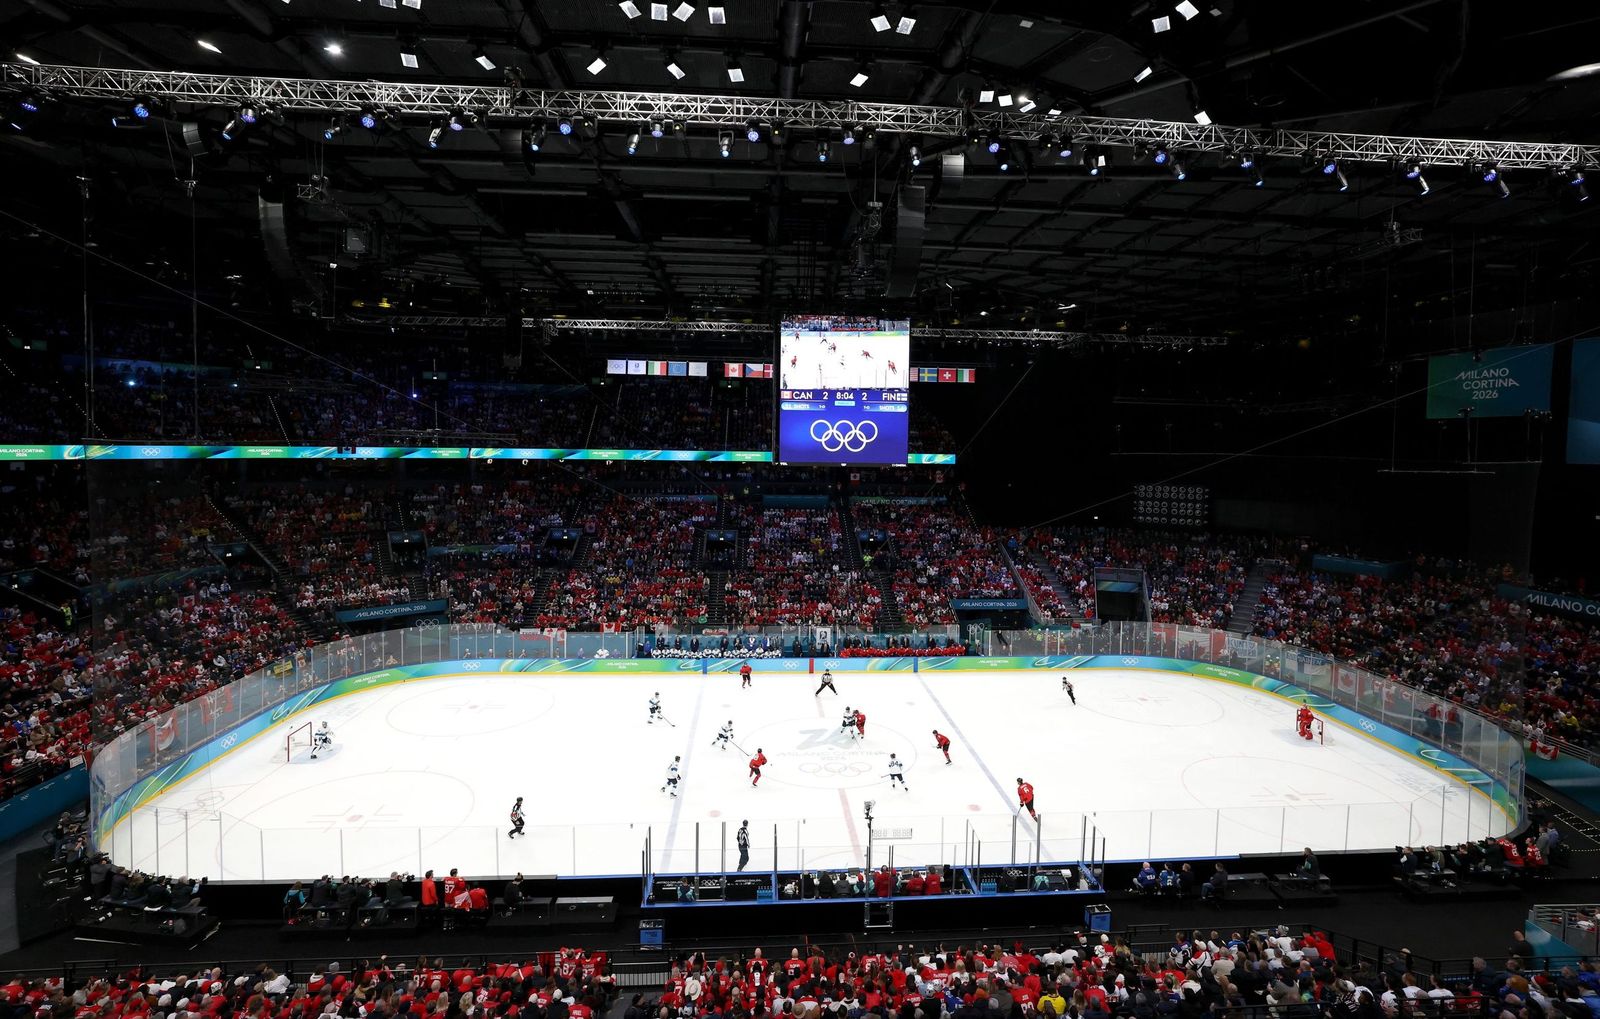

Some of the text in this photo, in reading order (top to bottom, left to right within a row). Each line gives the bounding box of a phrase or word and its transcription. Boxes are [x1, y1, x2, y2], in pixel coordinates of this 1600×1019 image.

[1456, 367, 1509, 380] MILANO
[1462, 378, 1520, 390] CORTINA
[793, 391, 897, 401] CAN 2 8:04 2 FIN
[1472, 390, 1499, 400] 2026
[1527, 593, 1583, 612] MILANO
[355, 604, 427, 618] MILANO CORTINA 2026
[444, 884, 455, 894] 97
